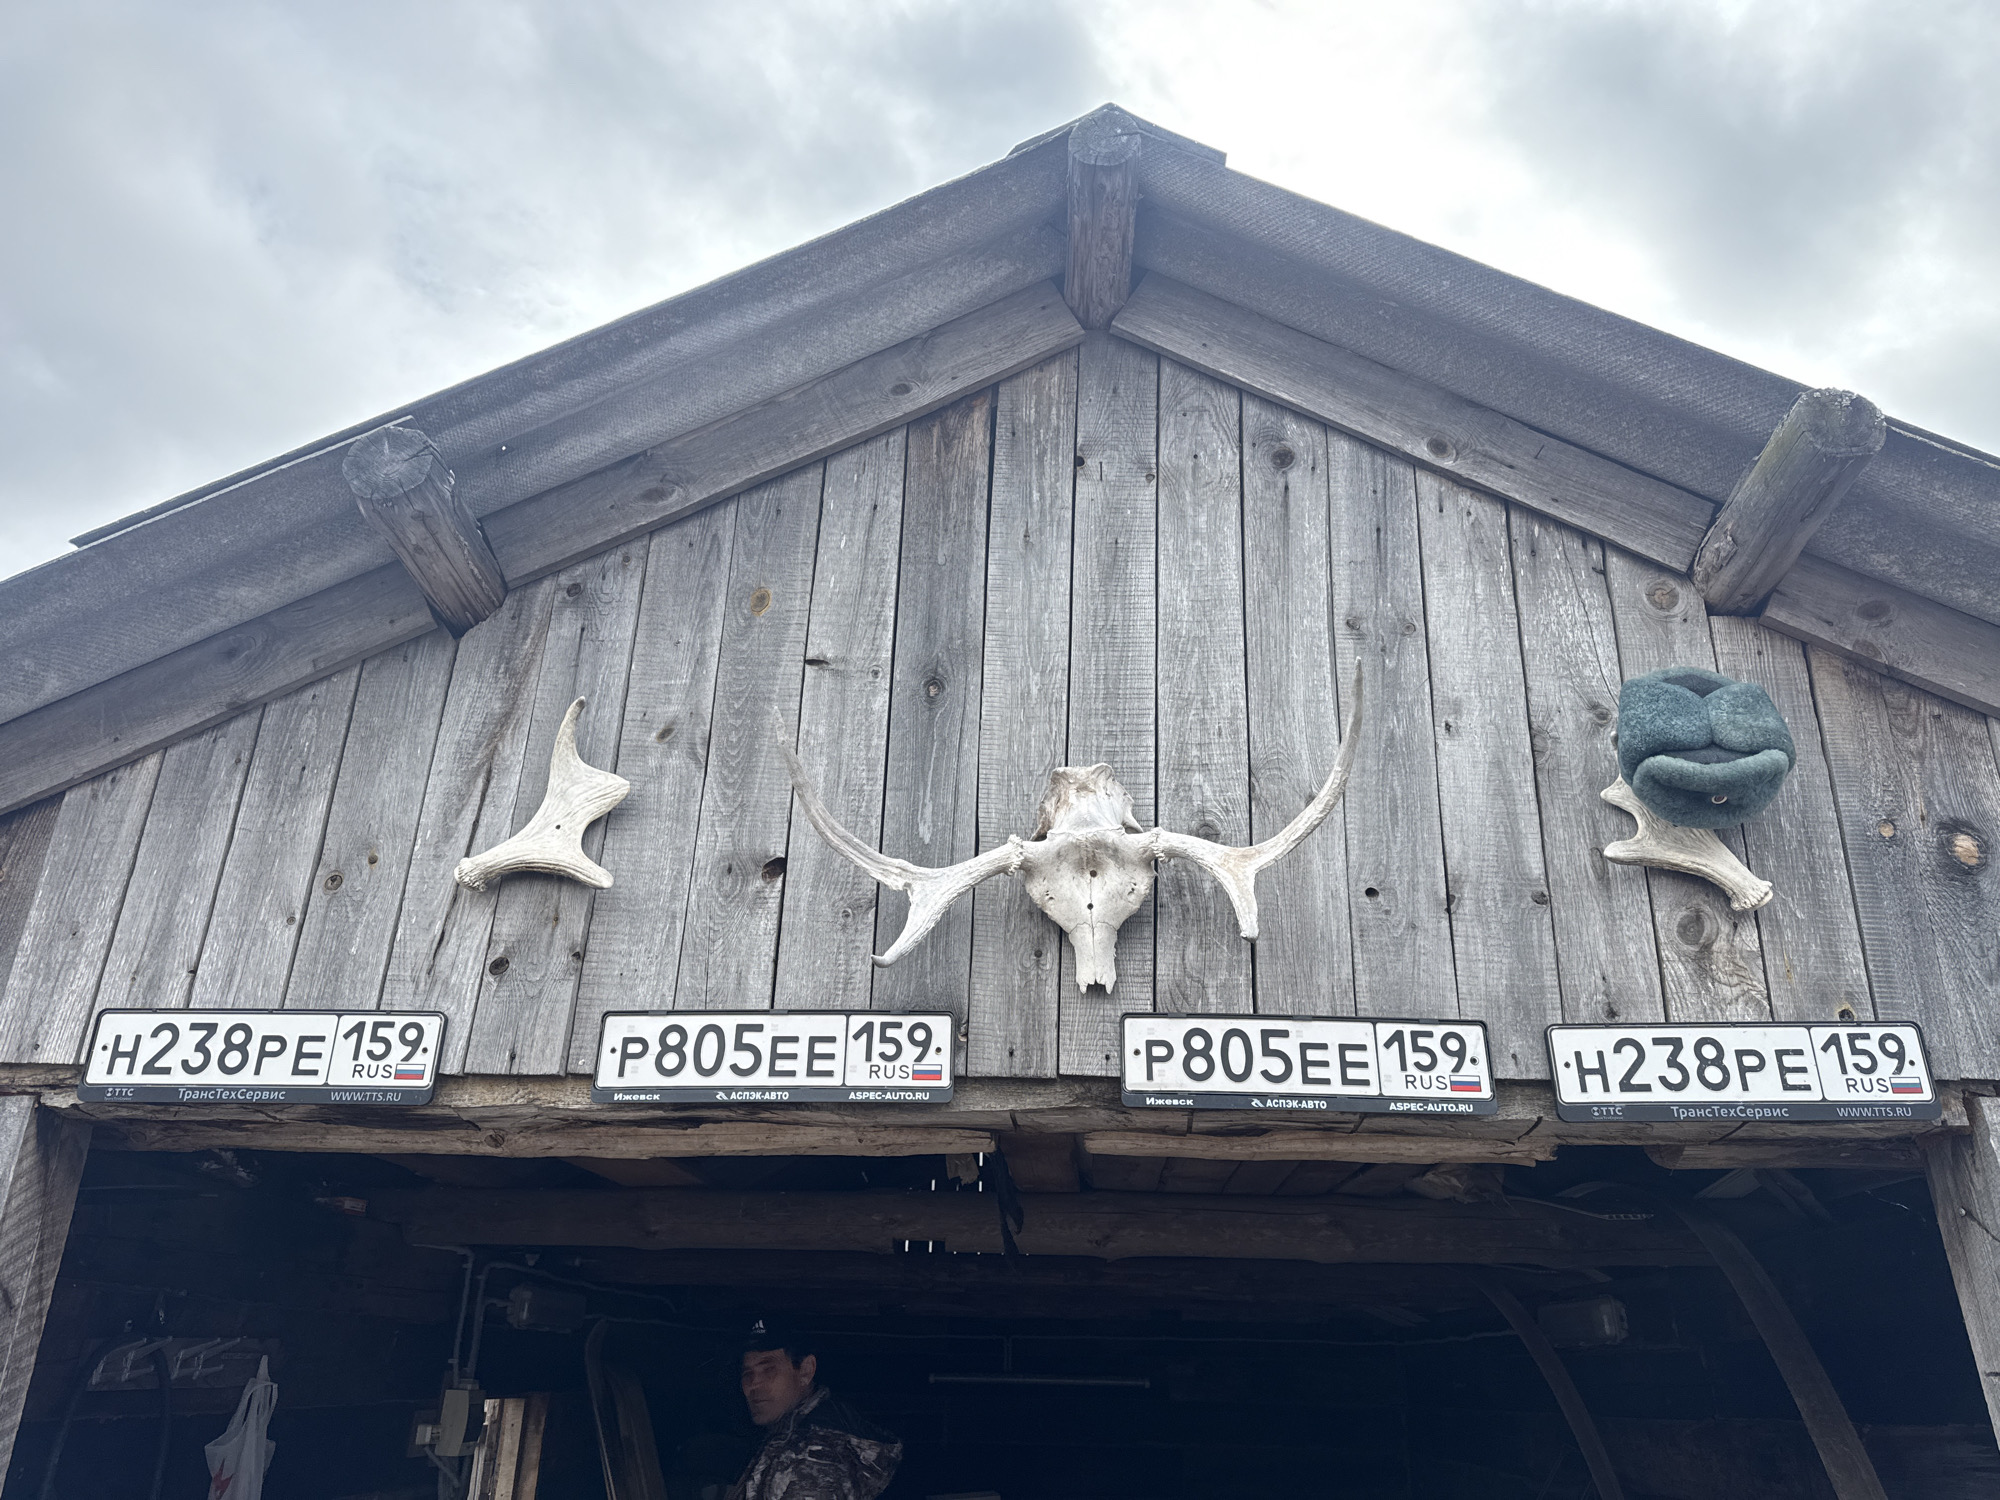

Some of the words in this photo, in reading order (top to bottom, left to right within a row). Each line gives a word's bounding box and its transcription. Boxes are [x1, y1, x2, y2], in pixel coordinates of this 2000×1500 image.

[342, 1020, 426, 1063] 159
[852, 1021, 933, 1063] 159
[1383, 1029, 1467, 1073] 159
[1820, 1032, 1906, 1076] 159
[352, 1063, 393, 1079] RUS
[869, 1064, 911, 1080] RUS
[1405, 1074, 1448, 1091] RUS
[1845, 1076, 1889, 1093] RUS
[177, 1087, 286, 1102] ТрансТехСервис
[330, 1091, 402, 1102] WWW.TTS.RU
[613, 1092, 660, 1101] Ижевск
[730, 1091, 789, 1101] АСПЭК-АВТО
[849, 1091, 930, 1101] ASPEC-AUTO.RU
[1145, 1096, 1194, 1106] Ижевск
[1266, 1098, 1327, 1110] АСПЭК-АВТО
[1389, 1102, 1474, 1113] ASPEC-AUTO.RU
[1671, 1106, 1789, 1119] ТрансТехСервис
[1836, 1107, 1912, 1117] WWW.TTS.RU
